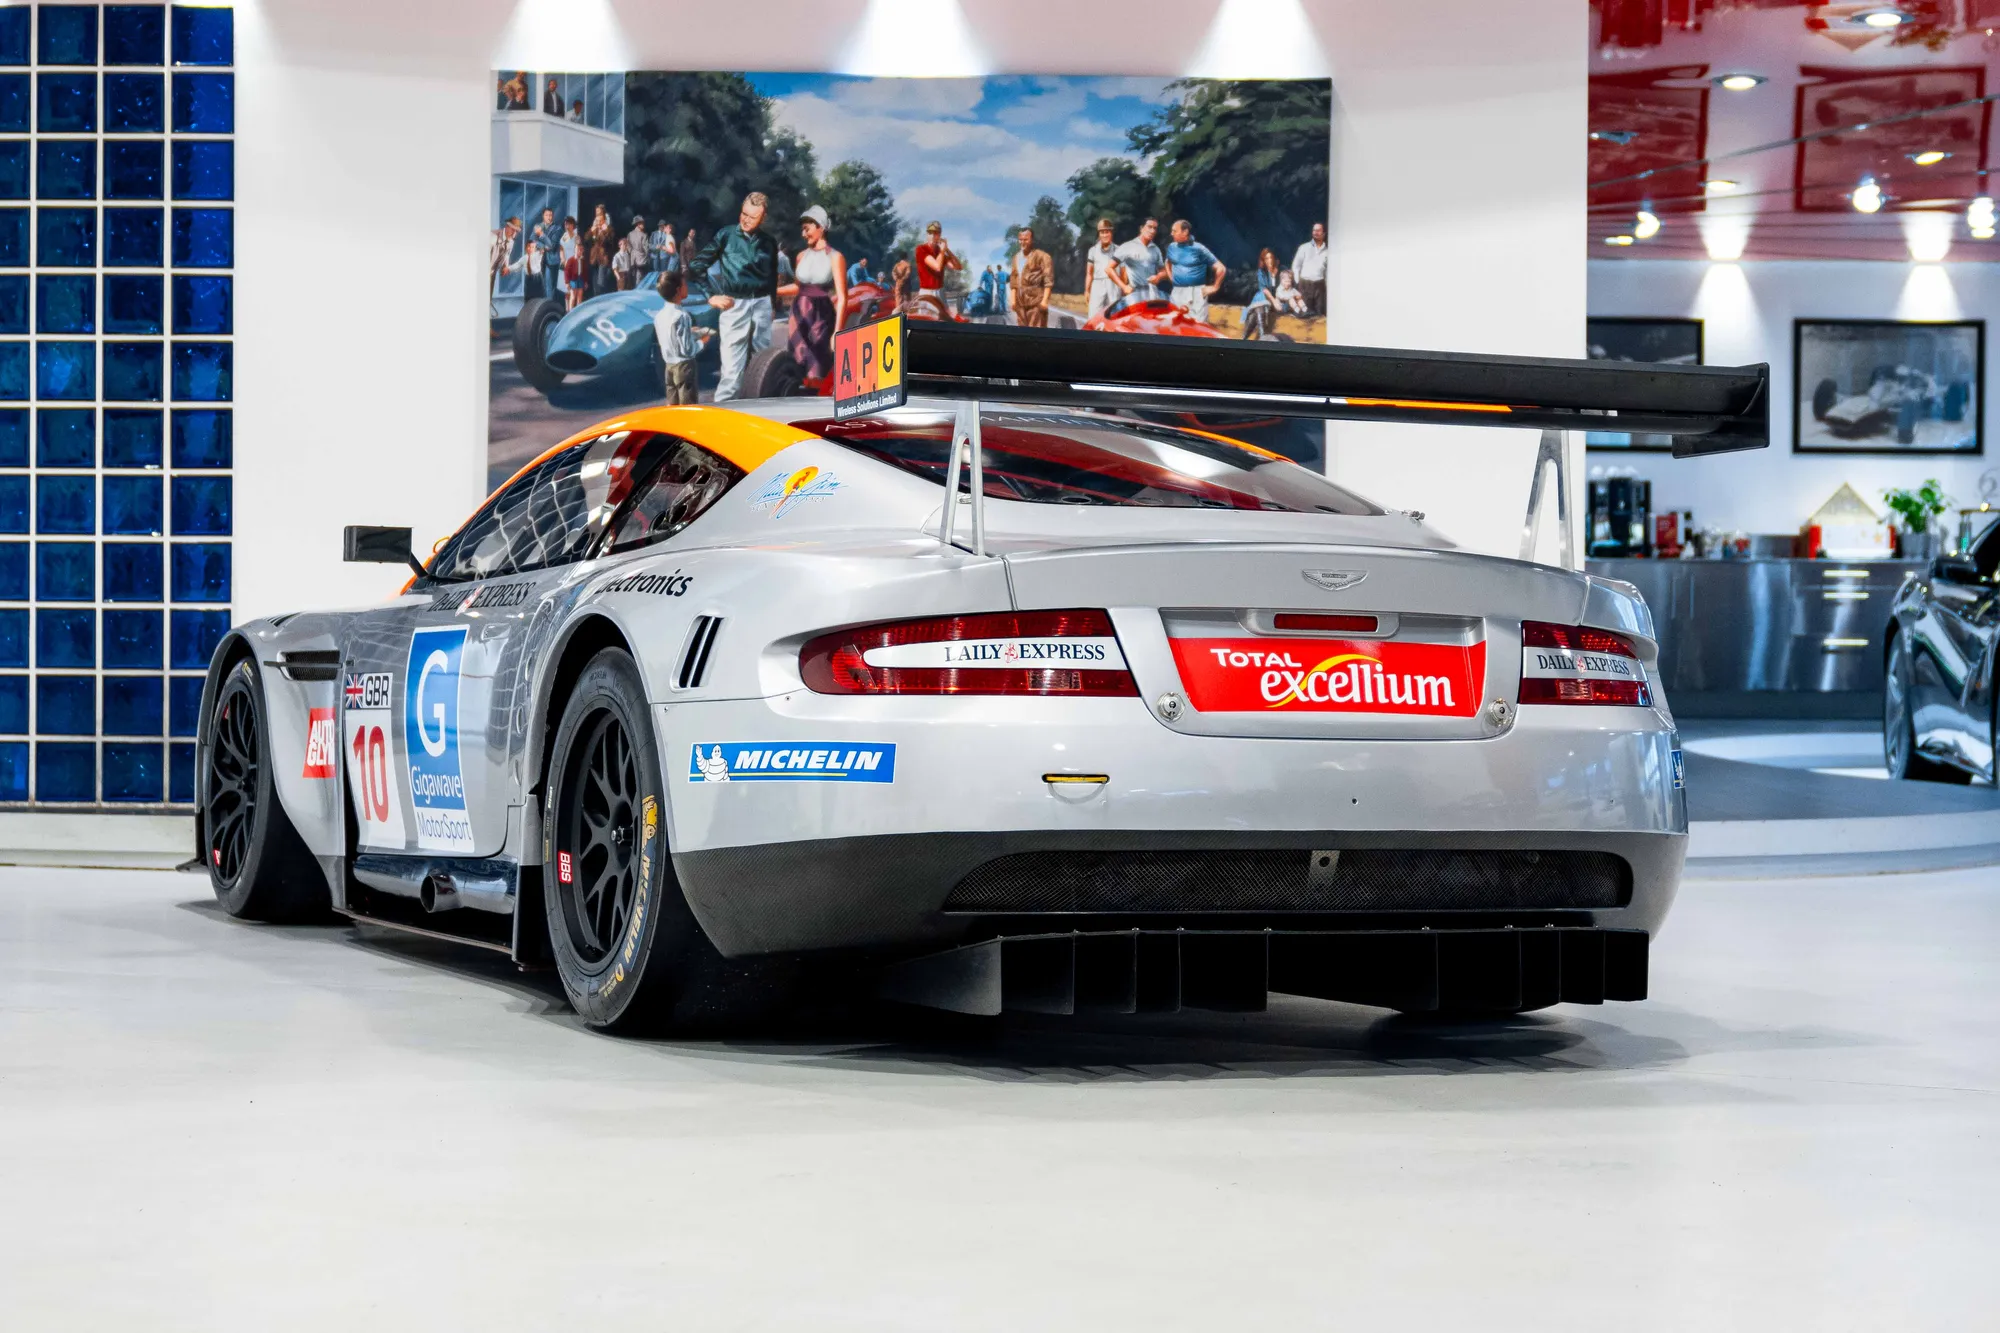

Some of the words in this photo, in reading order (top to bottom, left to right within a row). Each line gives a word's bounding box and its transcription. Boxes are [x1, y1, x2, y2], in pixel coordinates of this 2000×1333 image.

[586, 319, 627, 347] 18
[837, 406, 857, 418] Wireless
[857, 399, 879, 413] Solutions
[879, 392, 897, 407] Limited
[468, 581, 537, 608] EXPRESS
[1019, 643, 1105, 660] EXPRESS
[1210, 648, 1302, 667] TOTAL
[1537, 655, 1577, 670] DAILY
[1584, 656, 1630, 675] EXPRESS
[365, 675, 389, 706] GBR
[1260, 663, 1455, 706] excellium
[417, 649, 448, 757] G
[353, 725, 389, 823] 10
[734, 750, 883, 770] MICHELIN
[411, 766, 463, 804] Gigawave
[417, 812, 472, 845] MotorSport
[560, 853, 572, 882] BBS
